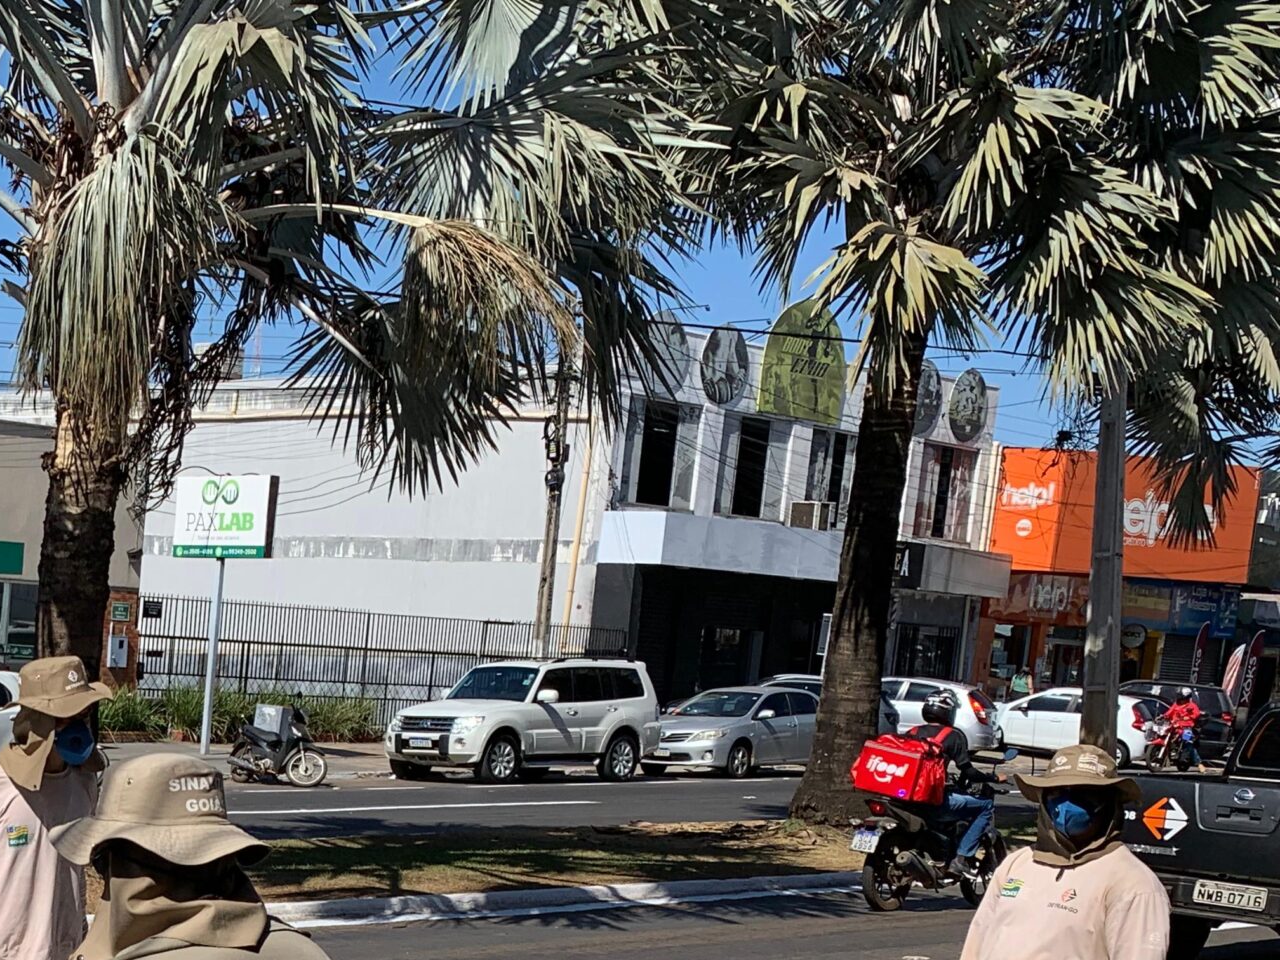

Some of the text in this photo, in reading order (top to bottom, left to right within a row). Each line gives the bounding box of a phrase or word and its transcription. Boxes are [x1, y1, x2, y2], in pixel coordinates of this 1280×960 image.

[185, 512, 254, 531] PAXLAB
[866, 754, 910, 778] ifood
[168, 776, 214, 792] SINA
[1197, 888, 1262, 908] NWB-0716
